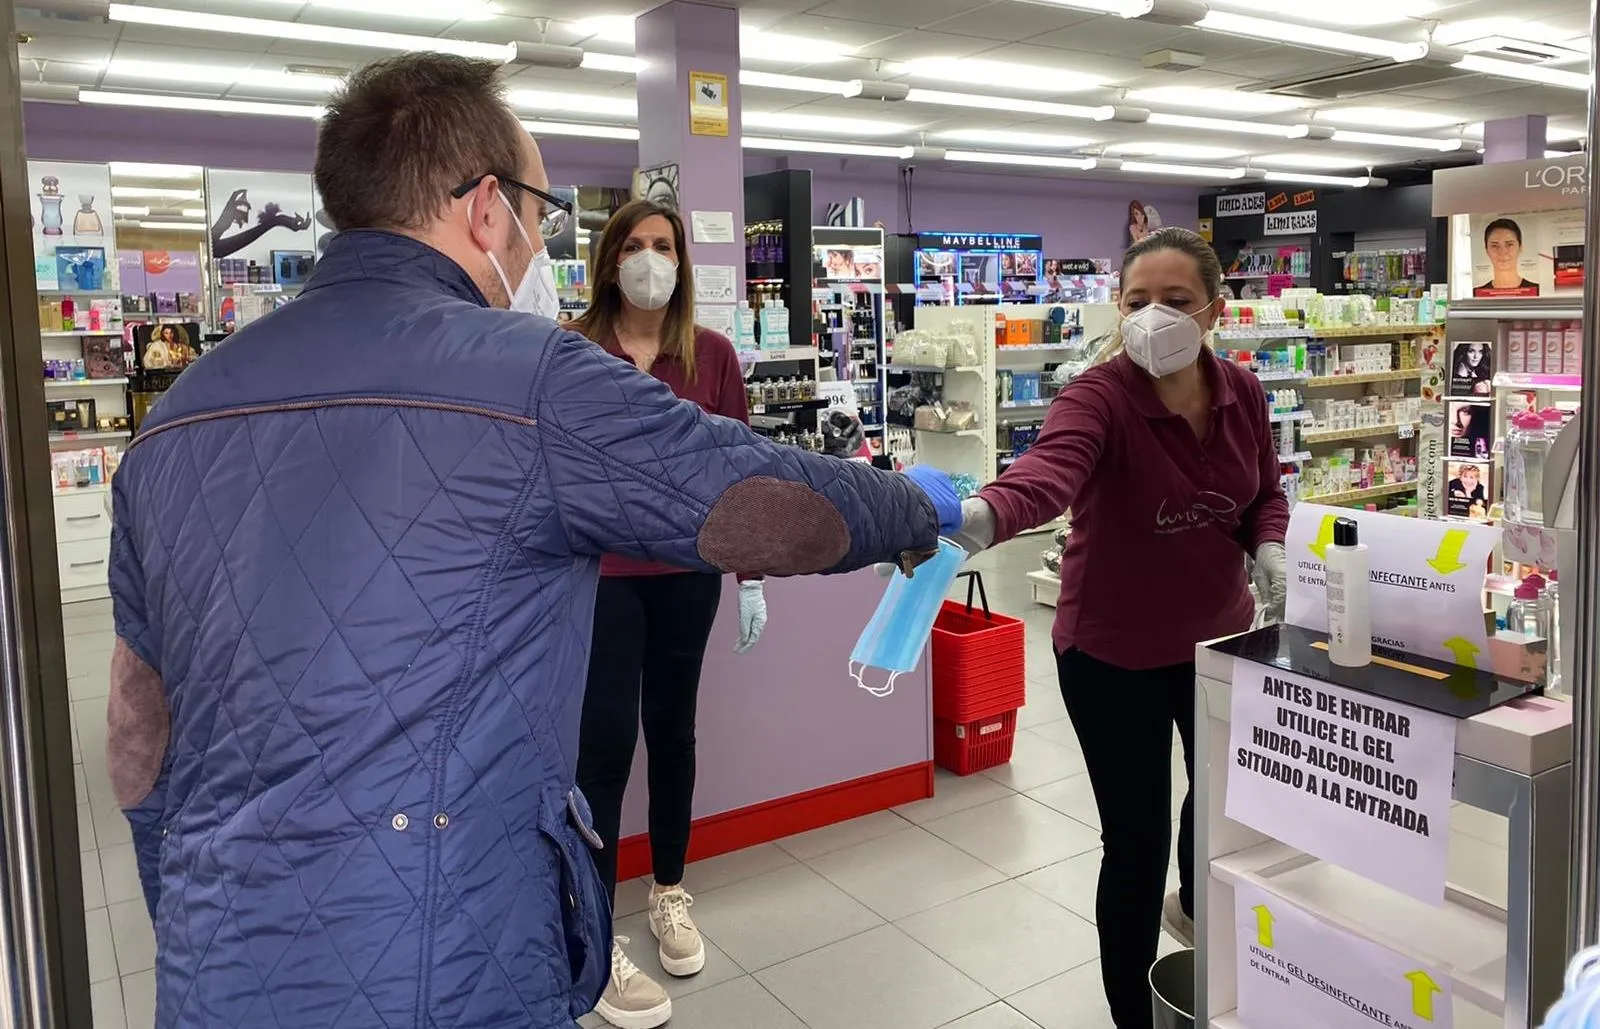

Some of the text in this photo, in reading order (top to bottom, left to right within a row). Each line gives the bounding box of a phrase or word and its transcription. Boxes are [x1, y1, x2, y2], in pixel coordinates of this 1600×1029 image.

[1525, 165, 1585, 188] L'OR
[1218, 195, 1265, 213] UNIDADES
[1267, 214, 1316, 231] LIMITADAS
[943, 236, 1021, 246] MAYBELLINE
[1424, 439, 1438, 520] jeunesse.com
[1298, 561, 1322, 571] UTILICE
[1298, 575, 1307, 584] DE
[1307, 577, 1327, 587] ENTRA
[1368, 569, 1456, 593] INFECTANTE ANTES
[1371, 636, 1405, 648] GRACIAS
[1263, 676, 1410, 738] ANTES DE ENTRAR
[1276, 707, 1394, 763] UTILICE EL GEL
[1252, 726, 1418, 800] HIDRO-ALCOHOLICO
[1237, 747, 1429, 837] SITUADO A LA ENTRADA
[1250, 959, 1290, 986] DE ENTRAR
[1250, 944, 1276, 964] UTILICE
[1277, 959, 1286, 969] EL
[1287, 962, 1306, 979] GEL
[1307, 974, 1392, 1025] DESINFECTANTE
